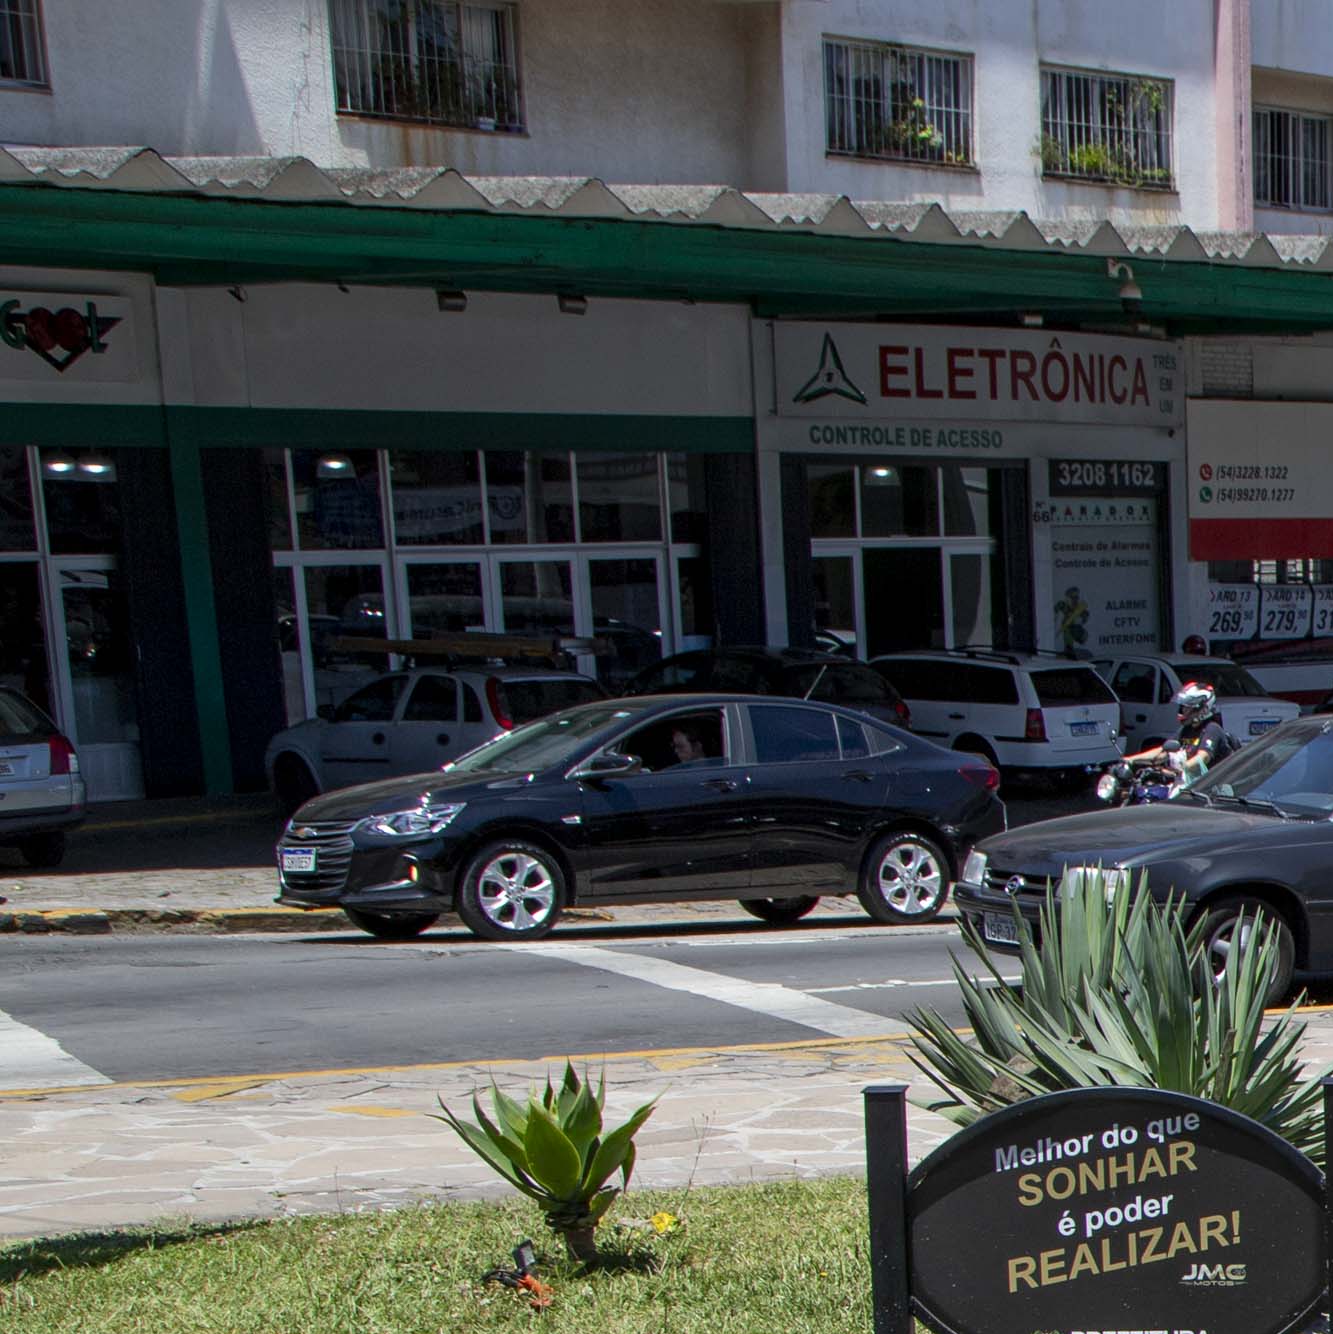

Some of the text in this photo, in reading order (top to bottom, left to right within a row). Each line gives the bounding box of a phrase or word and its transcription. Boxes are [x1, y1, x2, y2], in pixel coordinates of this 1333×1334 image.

[878, 337, 1151, 406] ELETRÔNICA
[809, 425, 1004, 449] CONTROLE DE ACESSO
[1059, 463, 1155, 486] 3208 1162
[1105, 599, 1147, 611] ALARME
[1114, 616, 1141, 628] CFTV
[1098, 633, 1156, 646] INTERFONE
[995, 1112, 1200, 1173] Melhor do que
[1017, 1141, 1198, 1207] SONHAR
[1058, 1194, 1174, 1237] é poder
[1008, 1210, 1241, 1293] REALIZAR!
[1182, 1264, 1247, 1280] JMC
